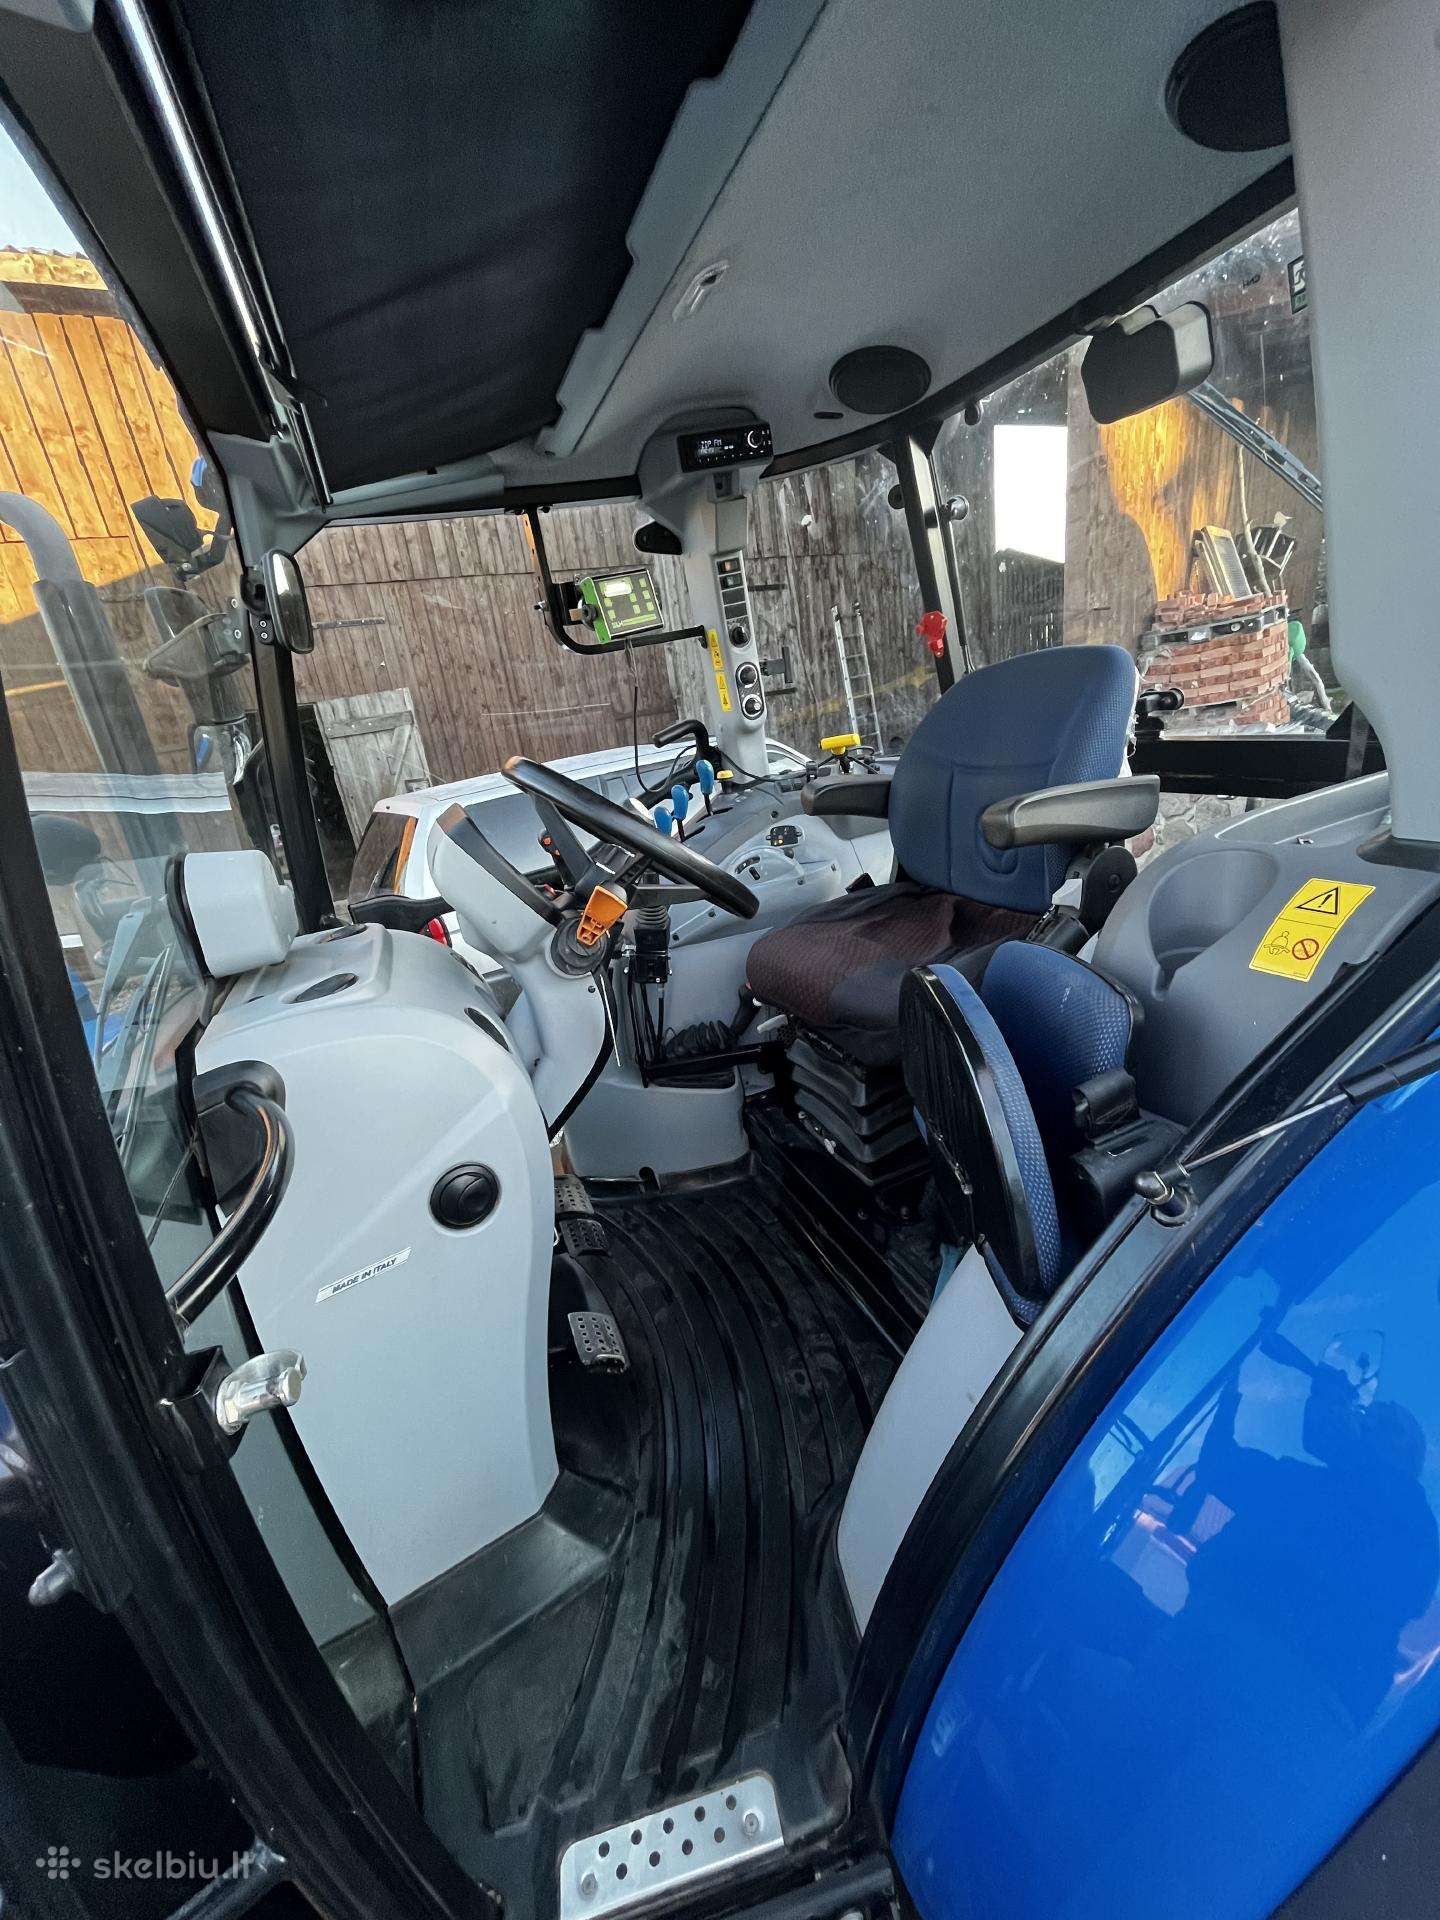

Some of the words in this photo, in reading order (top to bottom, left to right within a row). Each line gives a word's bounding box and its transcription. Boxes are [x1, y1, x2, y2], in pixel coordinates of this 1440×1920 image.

[332, 1275, 359, 1294] MADE
[361, 1269, 371, 1280] IN
[373, 1257, 396, 1274] ITALY
